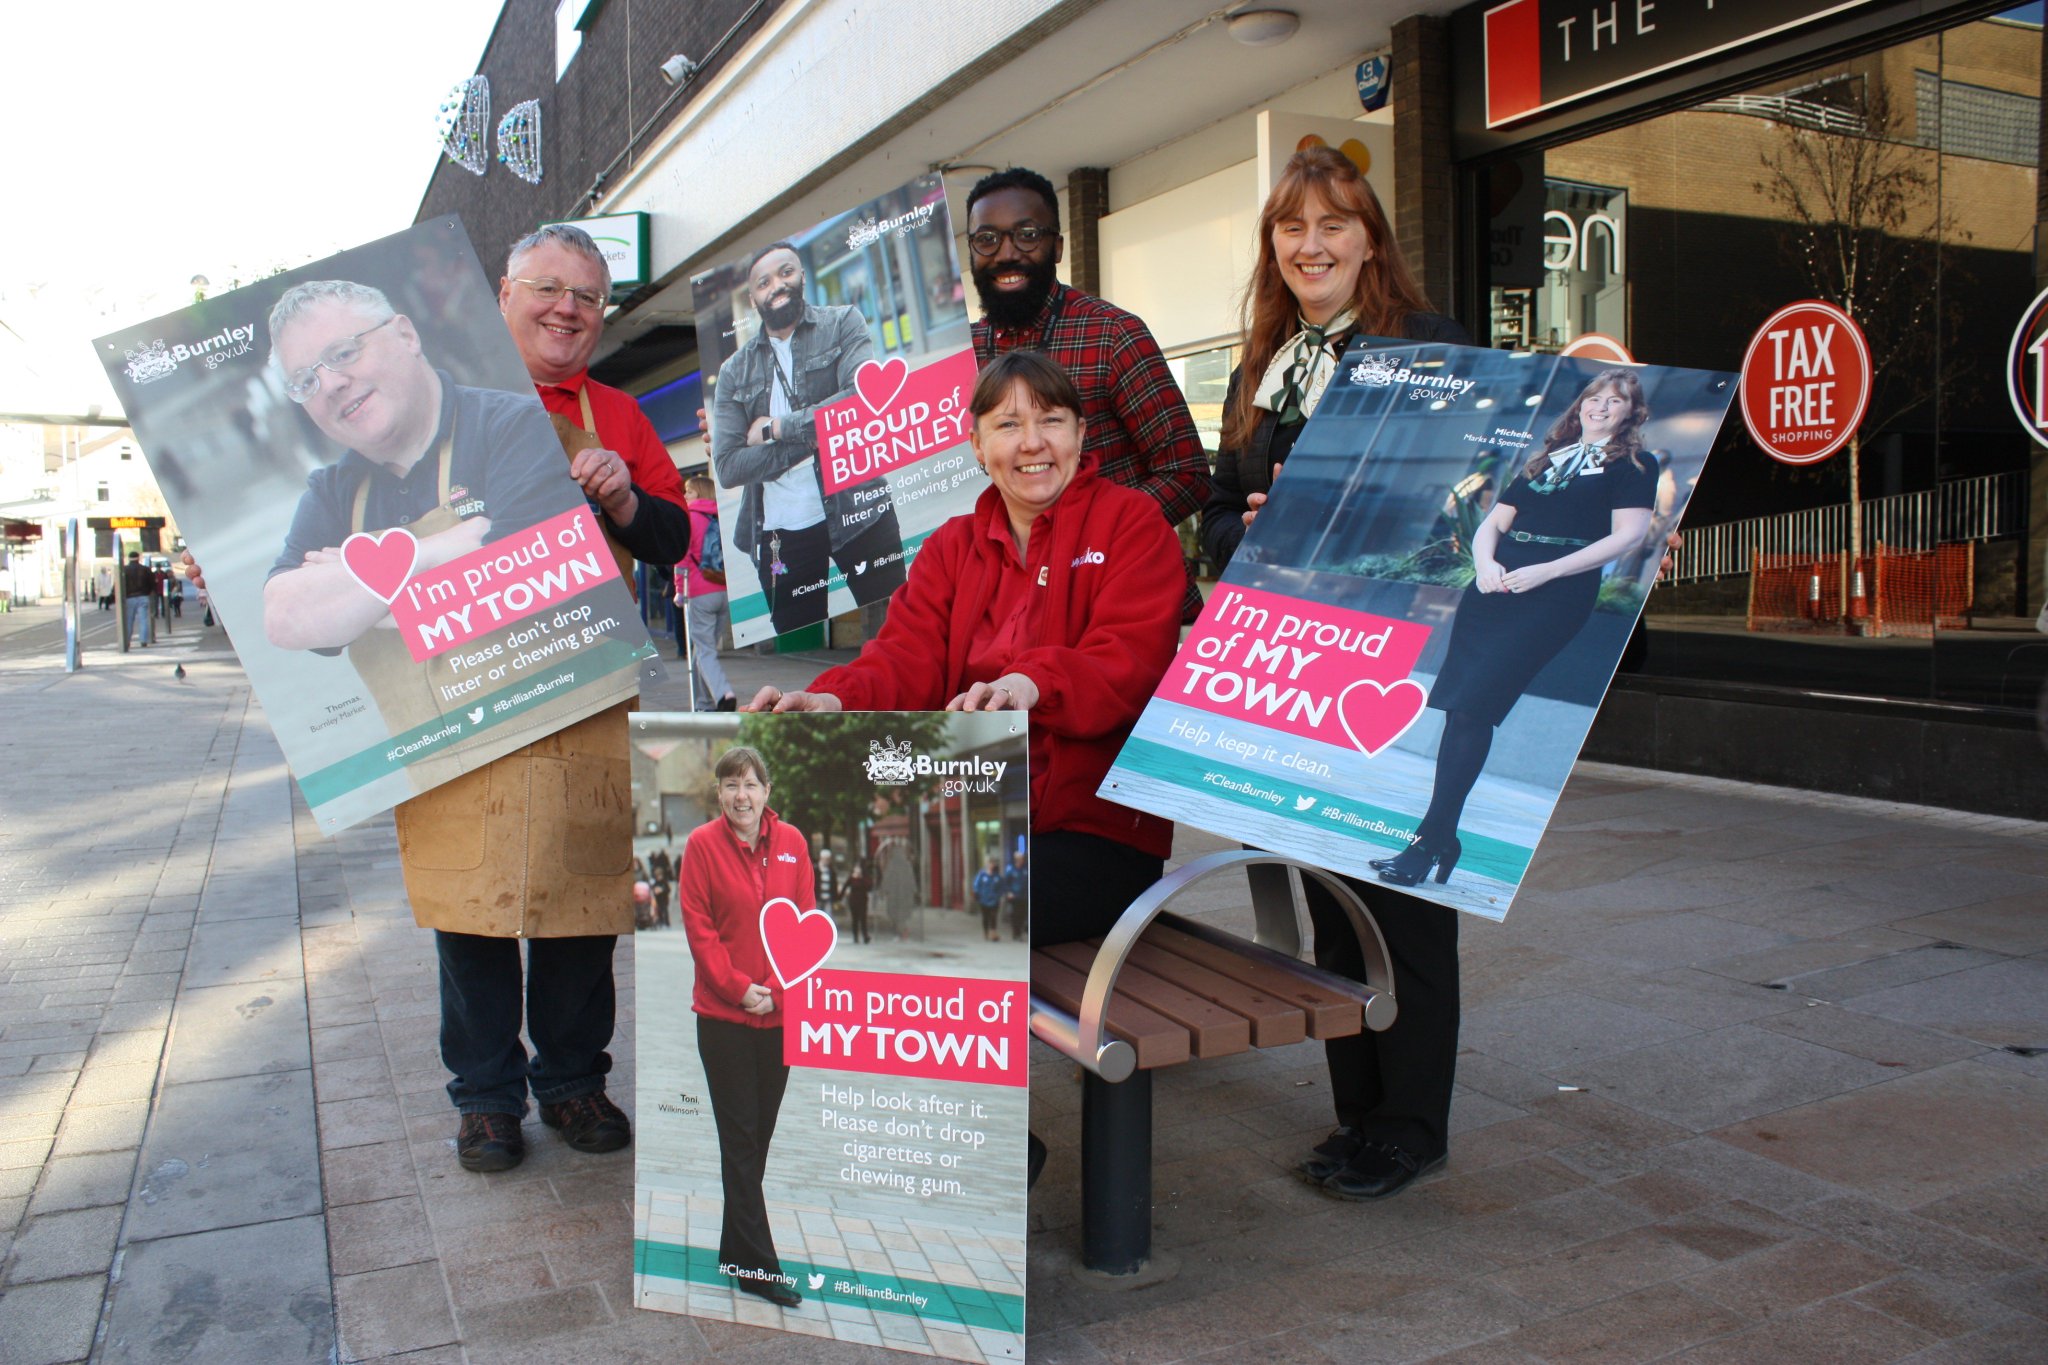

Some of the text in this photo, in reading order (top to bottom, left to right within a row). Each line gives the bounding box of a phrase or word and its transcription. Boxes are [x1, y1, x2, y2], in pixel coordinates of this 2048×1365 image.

[1558, 0, 1655, 62] THE
[878, 202, 934, 233] Burnley
[896, 215, 931, 238] .gov.uk
[172, 323, 254, 362] Burnley
[204, 340, 254, 370] .gov.uk
[1768, 324, 1836, 381] TAX
[1394, 368, 1476, 394] Burnley
[1408, 388, 1460, 402] .gov.uk
[824, 407, 858, 431] I'm
[828, 386, 960, 458] PROUD of
[1770, 382, 1836, 428] FREE
[832, 408, 966, 484] BURNLEY
[1464, 434, 1488, 444] Marks
[1497, 438, 1530, 449] Spencer
[1772, 429, 1833, 444] SHOPPING
[842, 466, 983, 527] litter or chewing gum.
[853, 456, 964, 506] Please don't drop
[407, 514, 586, 611] I'm proud of
[792, 544, 922, 598] #CleanBurnley #BrilliantBur
[418, 552, 602, 650] MY TOWN
[450, 605, 592, 674] Please don't drop
[1214, 592, 1394, 658] I'm proud
[440, 617, 620, 701] litter or chewing gum.
[1196, 632, 1322, 680] of MY
[310, 704, 367, 733] Burnley Market
[386, 672, 576, 762] #CleanBurnley #BrilliantBurnley
[1182, 662, 1332, 728] TOWN
[916, 754, 1008, 782] Burnley
[1168, 718, 1332, 778] Help keep it clean.
[941, 776, 996, 798] .gov.uk
[1202, 771, 1422, 846] #CleanBurnley #BrilliantBurnley
[807, 977, 1014, 1024] I'm proud of
[800, 1020, 1009, 1070] MY TOWN
[658, 1104, 699, 1116] Wilkinson's
[821, 1084, 988, 1119] Help look after it.
[822, 1109, 985, 1150] Please don't drop
[843, 1139, 962, 1168] cigarettes or
[840, 1163, 966, 1196] chewing gum.
[719, 1262, 928, 1310] #CleanBurnley #BrilliantBurnley
